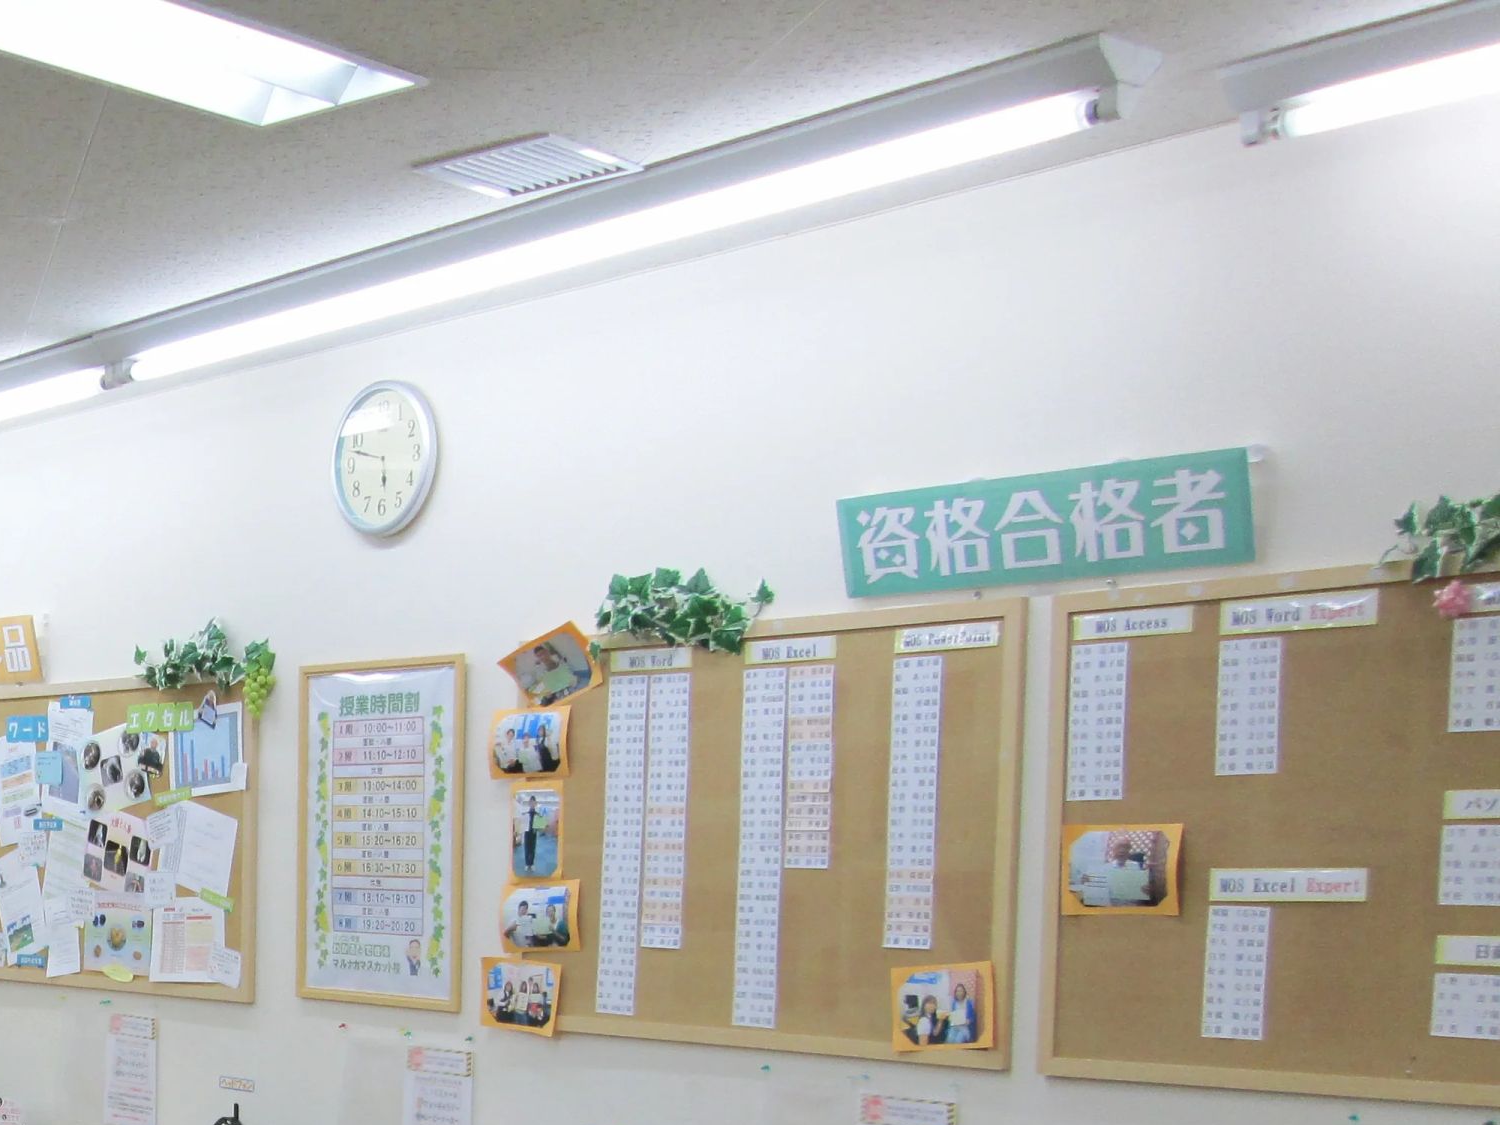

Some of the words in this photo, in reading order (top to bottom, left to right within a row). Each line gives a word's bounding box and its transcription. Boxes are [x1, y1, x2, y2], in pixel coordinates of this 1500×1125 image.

[407, 419, 416, 438] 2
[412, 444, 421, 461] 3
[346, 457, 355, 475] 9
[405, 469, 414, 486] 4
[352, 480, 361, 497] 8
[363, 496, 371, 513] 7
[377, 498, 386, 516] 6
[394, 491, 403, 508] 5
[855, 468, 1227, 585] 資格合格者
[1265, 607, 1300, 623] Word
[1124, 617, 1169, 631] Access
[785, 643, 818, 658] Excel
[650, 654, 674, 667] Word
[339, 691, 420, 717] 授業時間割
[129, 704, 190, 729] エクセル
[8, 721, 47, 740] ワード
[1253, 877, 1296, 893] Excel
[1306, 877, 1361, 894] Expert
